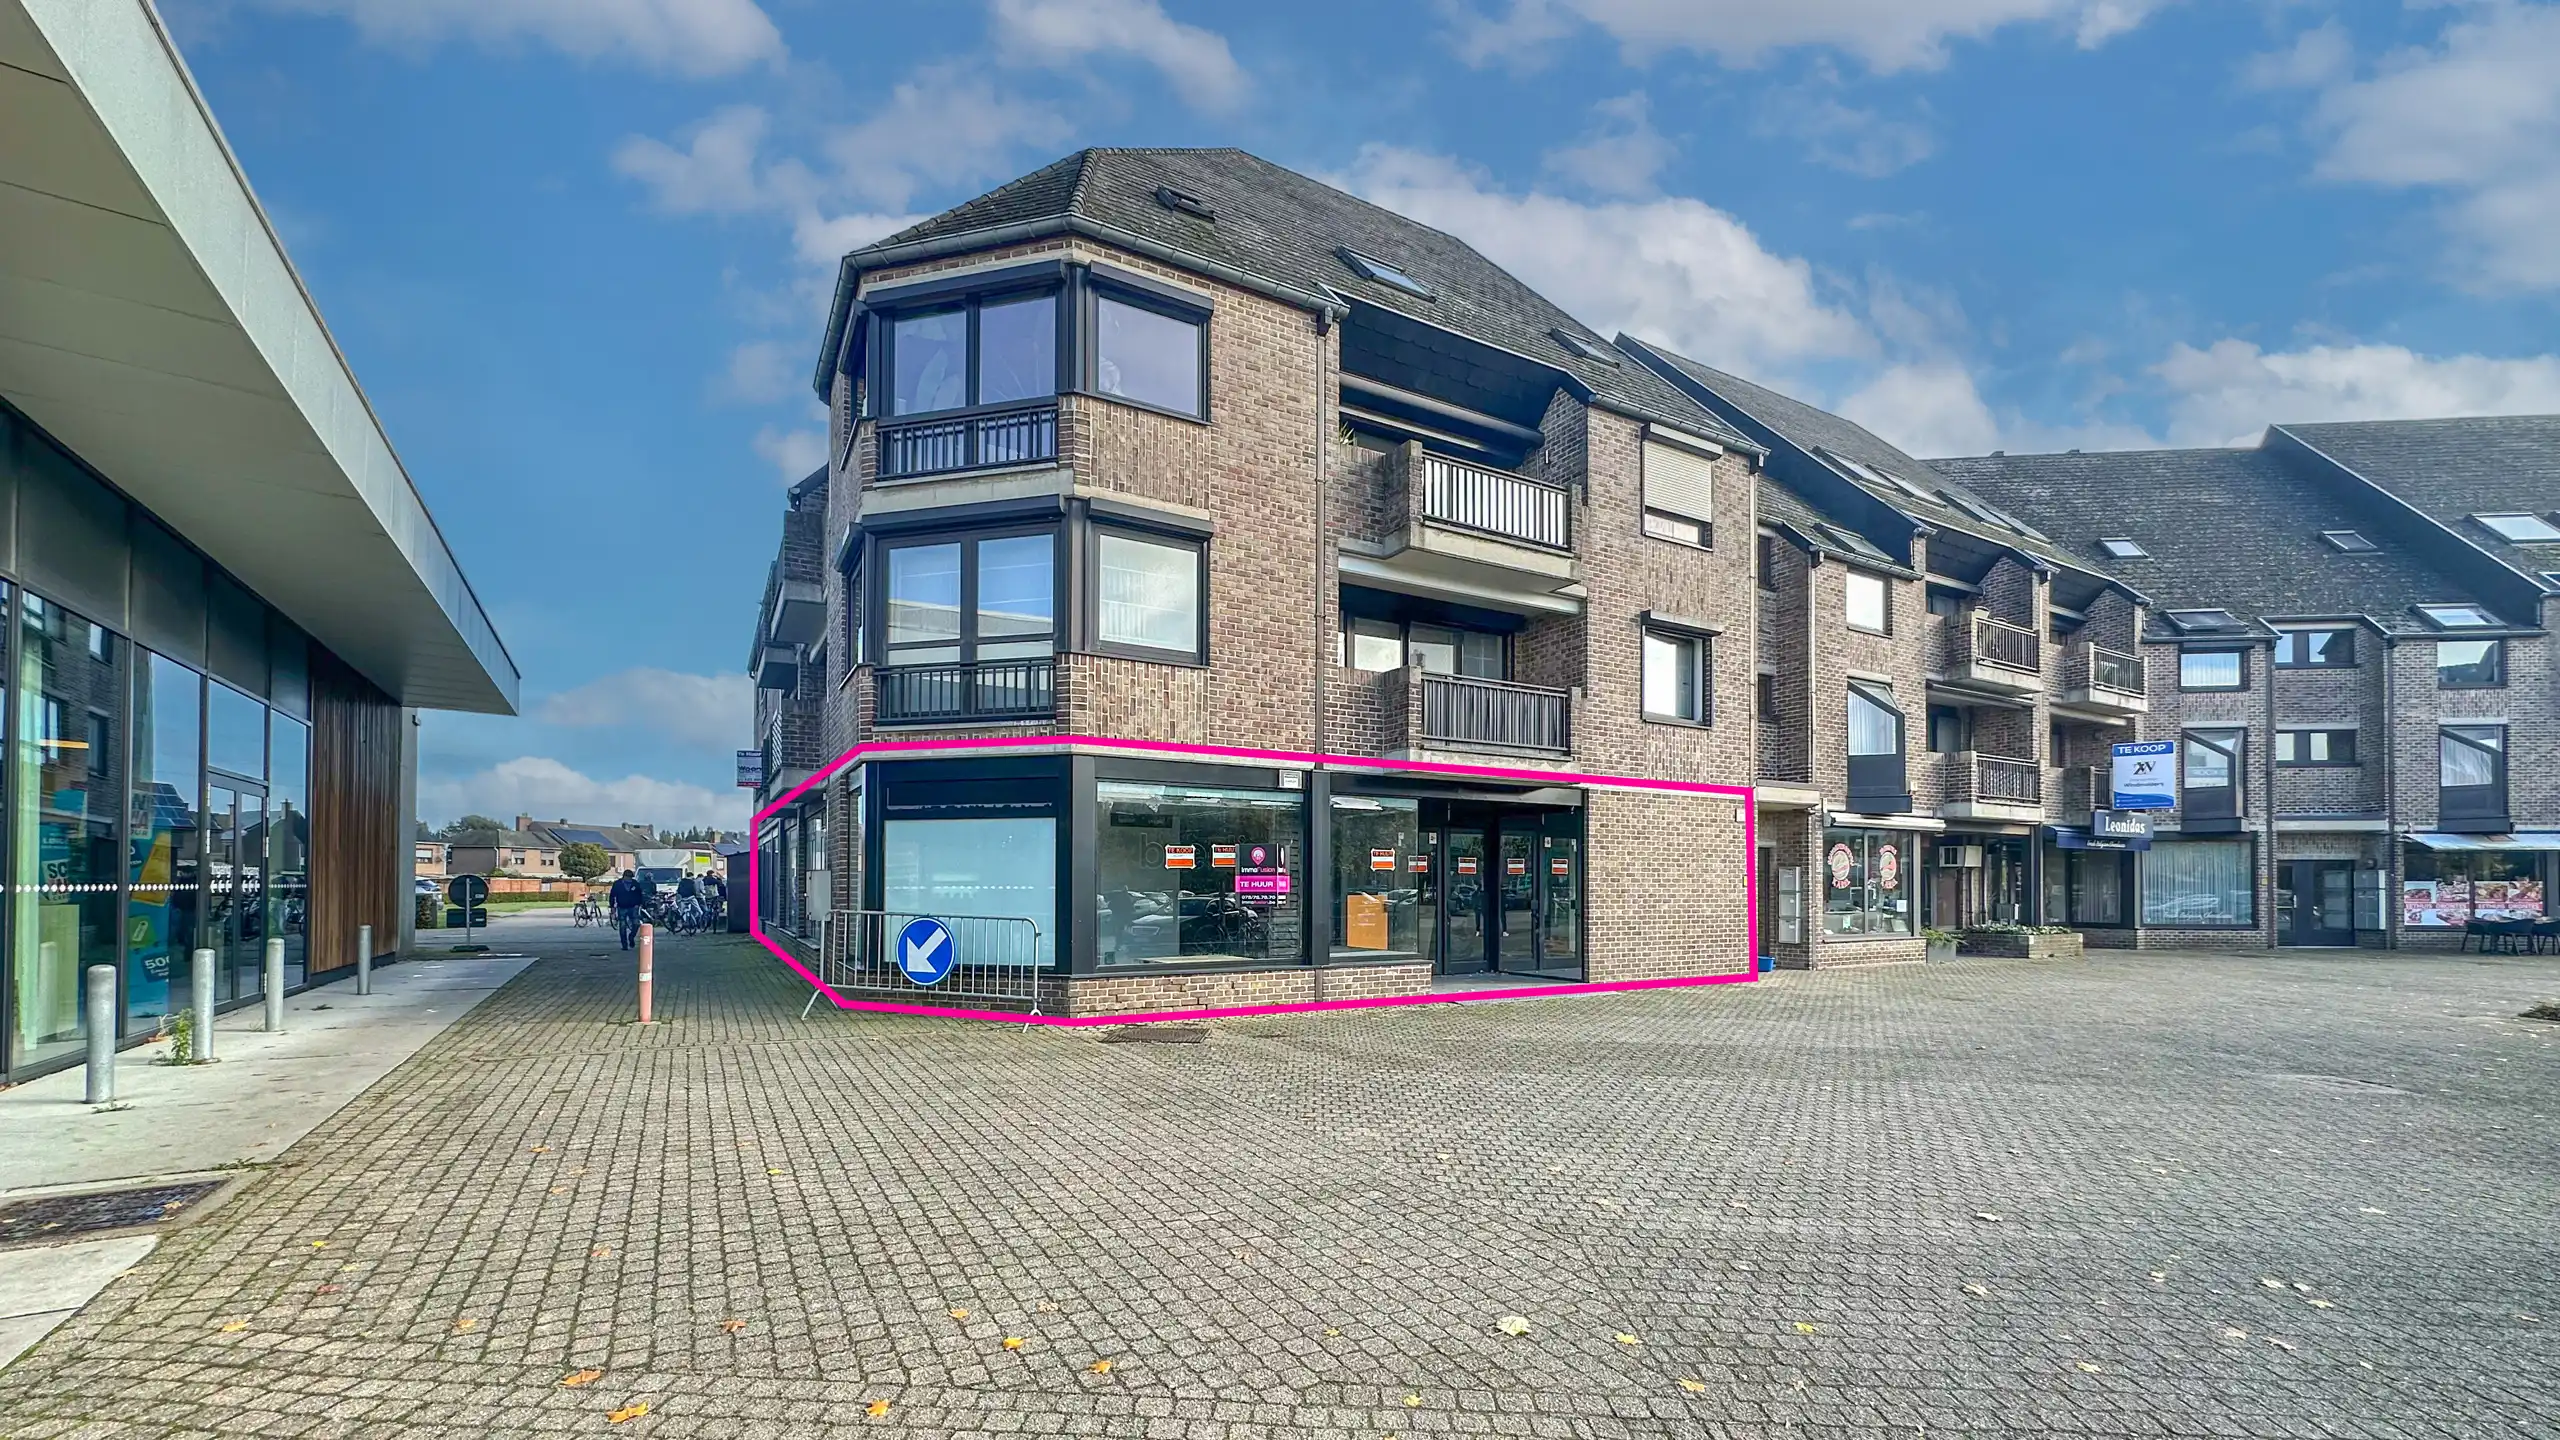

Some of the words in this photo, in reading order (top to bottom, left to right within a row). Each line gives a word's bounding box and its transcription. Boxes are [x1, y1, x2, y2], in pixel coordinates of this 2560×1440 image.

[2118, 746, 2132, 754] TE
[2134, 744, 2167, 753] KOOP
[2105, 815, 2146, 834] Leonidas
